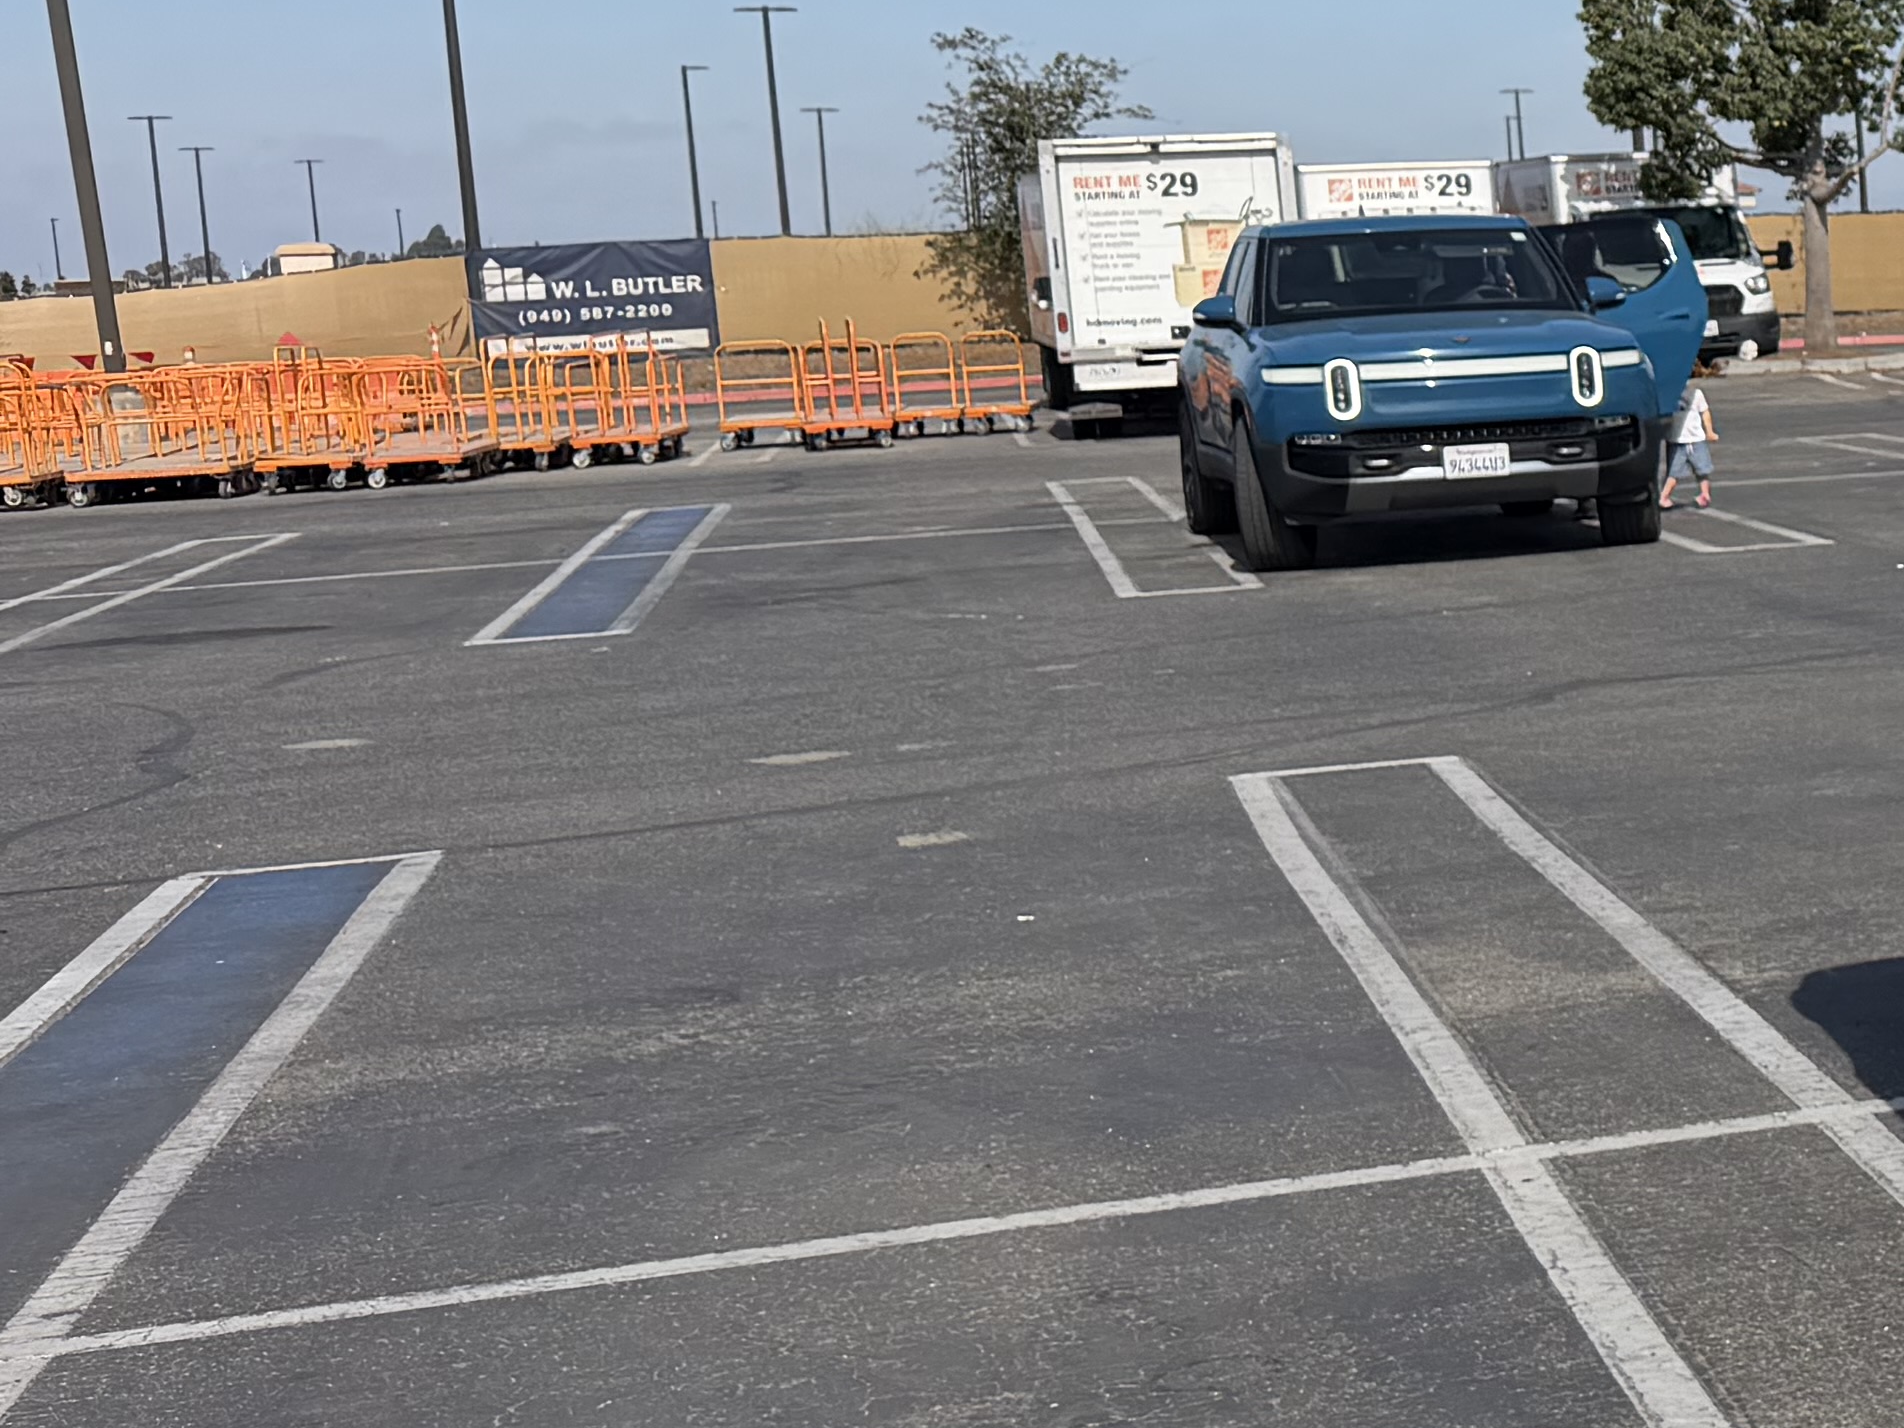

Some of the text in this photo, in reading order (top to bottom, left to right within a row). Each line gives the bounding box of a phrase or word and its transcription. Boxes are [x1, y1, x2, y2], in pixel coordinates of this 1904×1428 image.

[1073, 172, 1198, 197] RENT ME $29
[1074, 191, 1125, 202] STARTING
[1358, 173, 1472, 197] RENT ME $29
[551, 275, 704, 299] W. L. BUTLER
[580, 303, 672, 321] 587-2200
